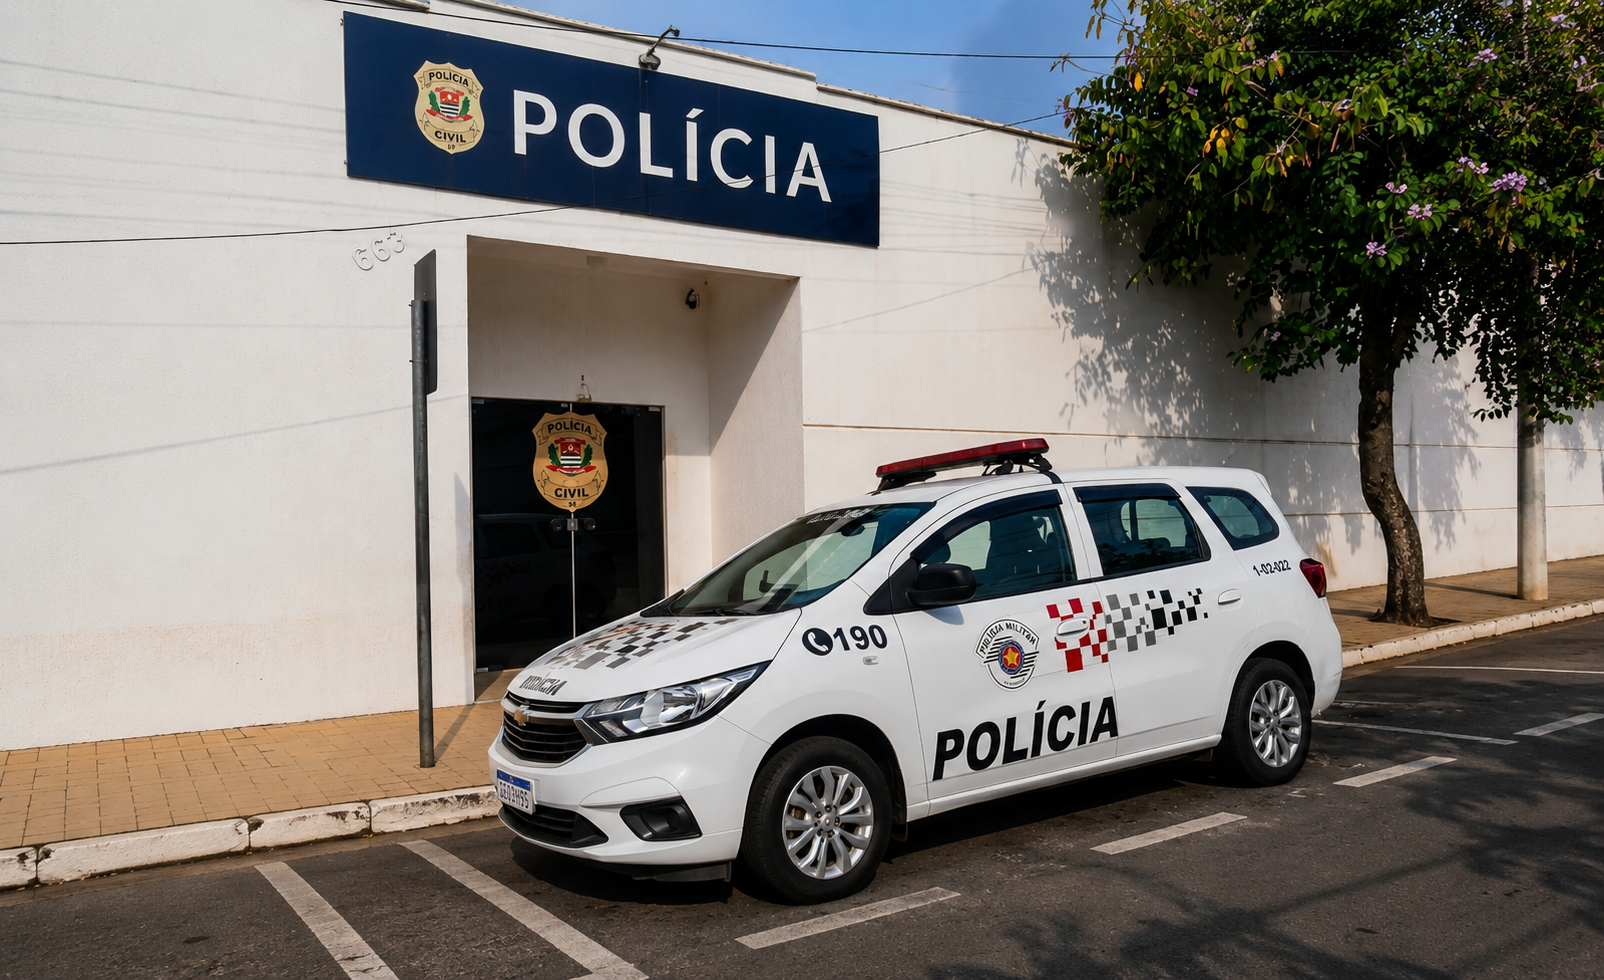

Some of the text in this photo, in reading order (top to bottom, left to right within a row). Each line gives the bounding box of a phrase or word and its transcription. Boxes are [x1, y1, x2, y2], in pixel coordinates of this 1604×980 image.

[434, 130, 467, 143] CIVIL
[513, 89, 832, 203] POLÍCIA
[351, 231, 406, 271] 663
[554, 487, 589, 498] CIVIL
[1252, 559, 1292, 577] 1-02-022
[832, 624, 888, 651] 190
[932, 696, 1119, 782] POLÍCIA
